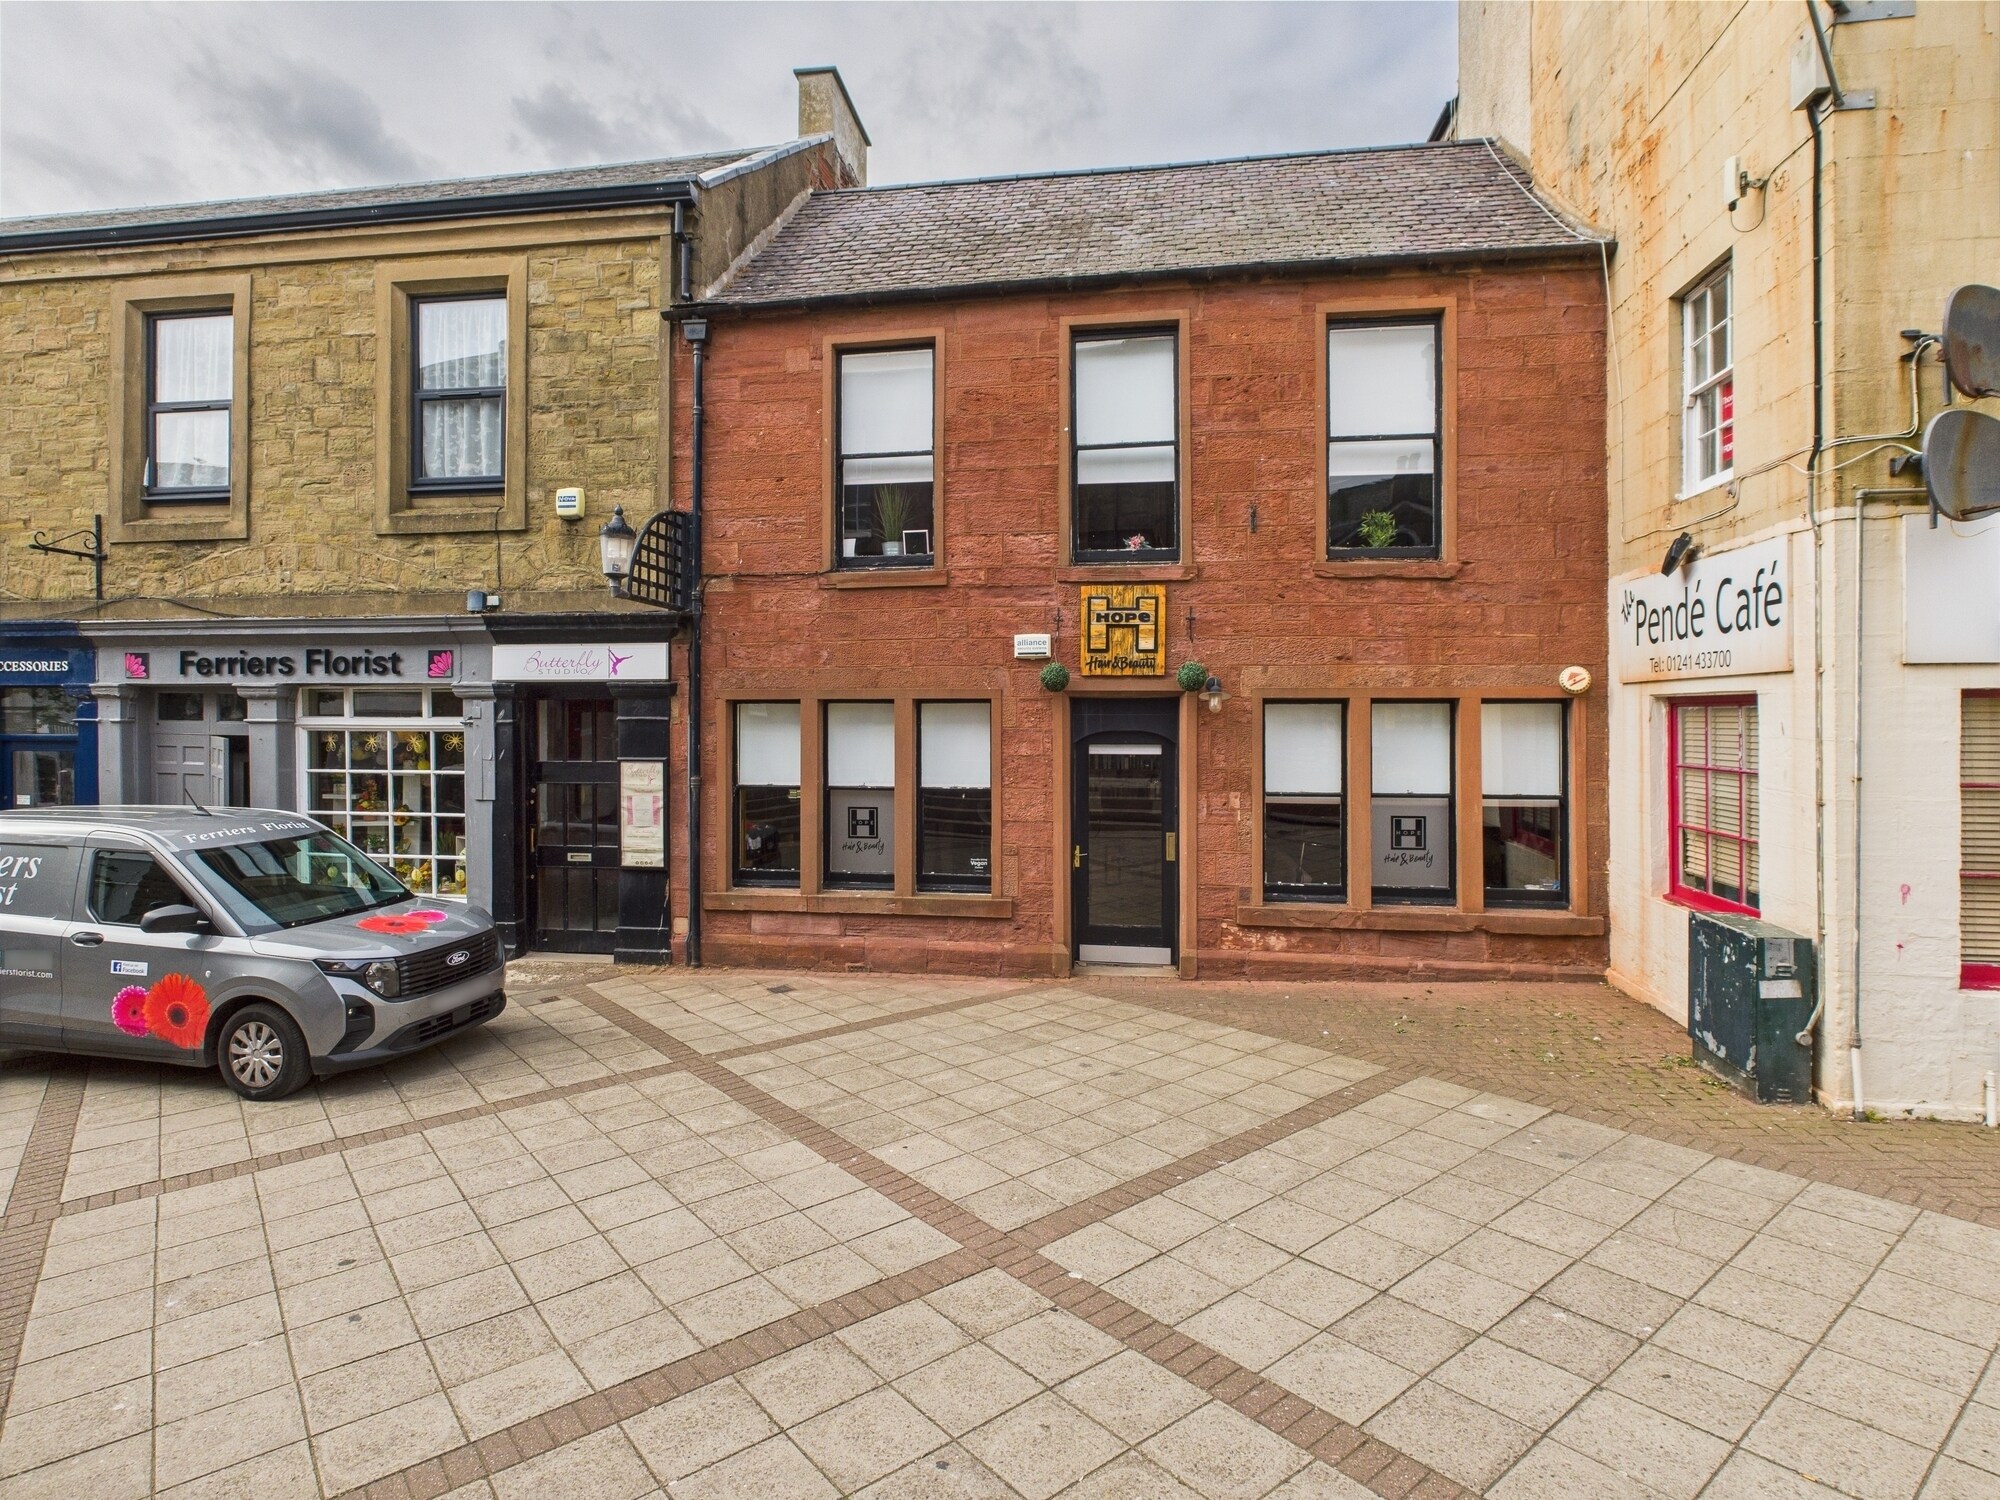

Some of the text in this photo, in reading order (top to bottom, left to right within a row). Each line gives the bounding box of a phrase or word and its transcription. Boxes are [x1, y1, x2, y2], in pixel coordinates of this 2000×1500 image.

[1636, 579, 1705, 646] Pendé
[1716, 560, 1783, 634] Café
[179, 649, 403, 676] Ferriers Florist
[523, 650, 603, 675] Butterfly
[1649, 649, 1732, 673] Tel: 01241 433700
[183, 820, 310, 844] Ferriers Florist
[856, 841, 863, 853] &
[864, 838, 885, 855] Beauty
[1400, 852, 1409, 866] &
[1409, 849, 1434, 868] Beauty
